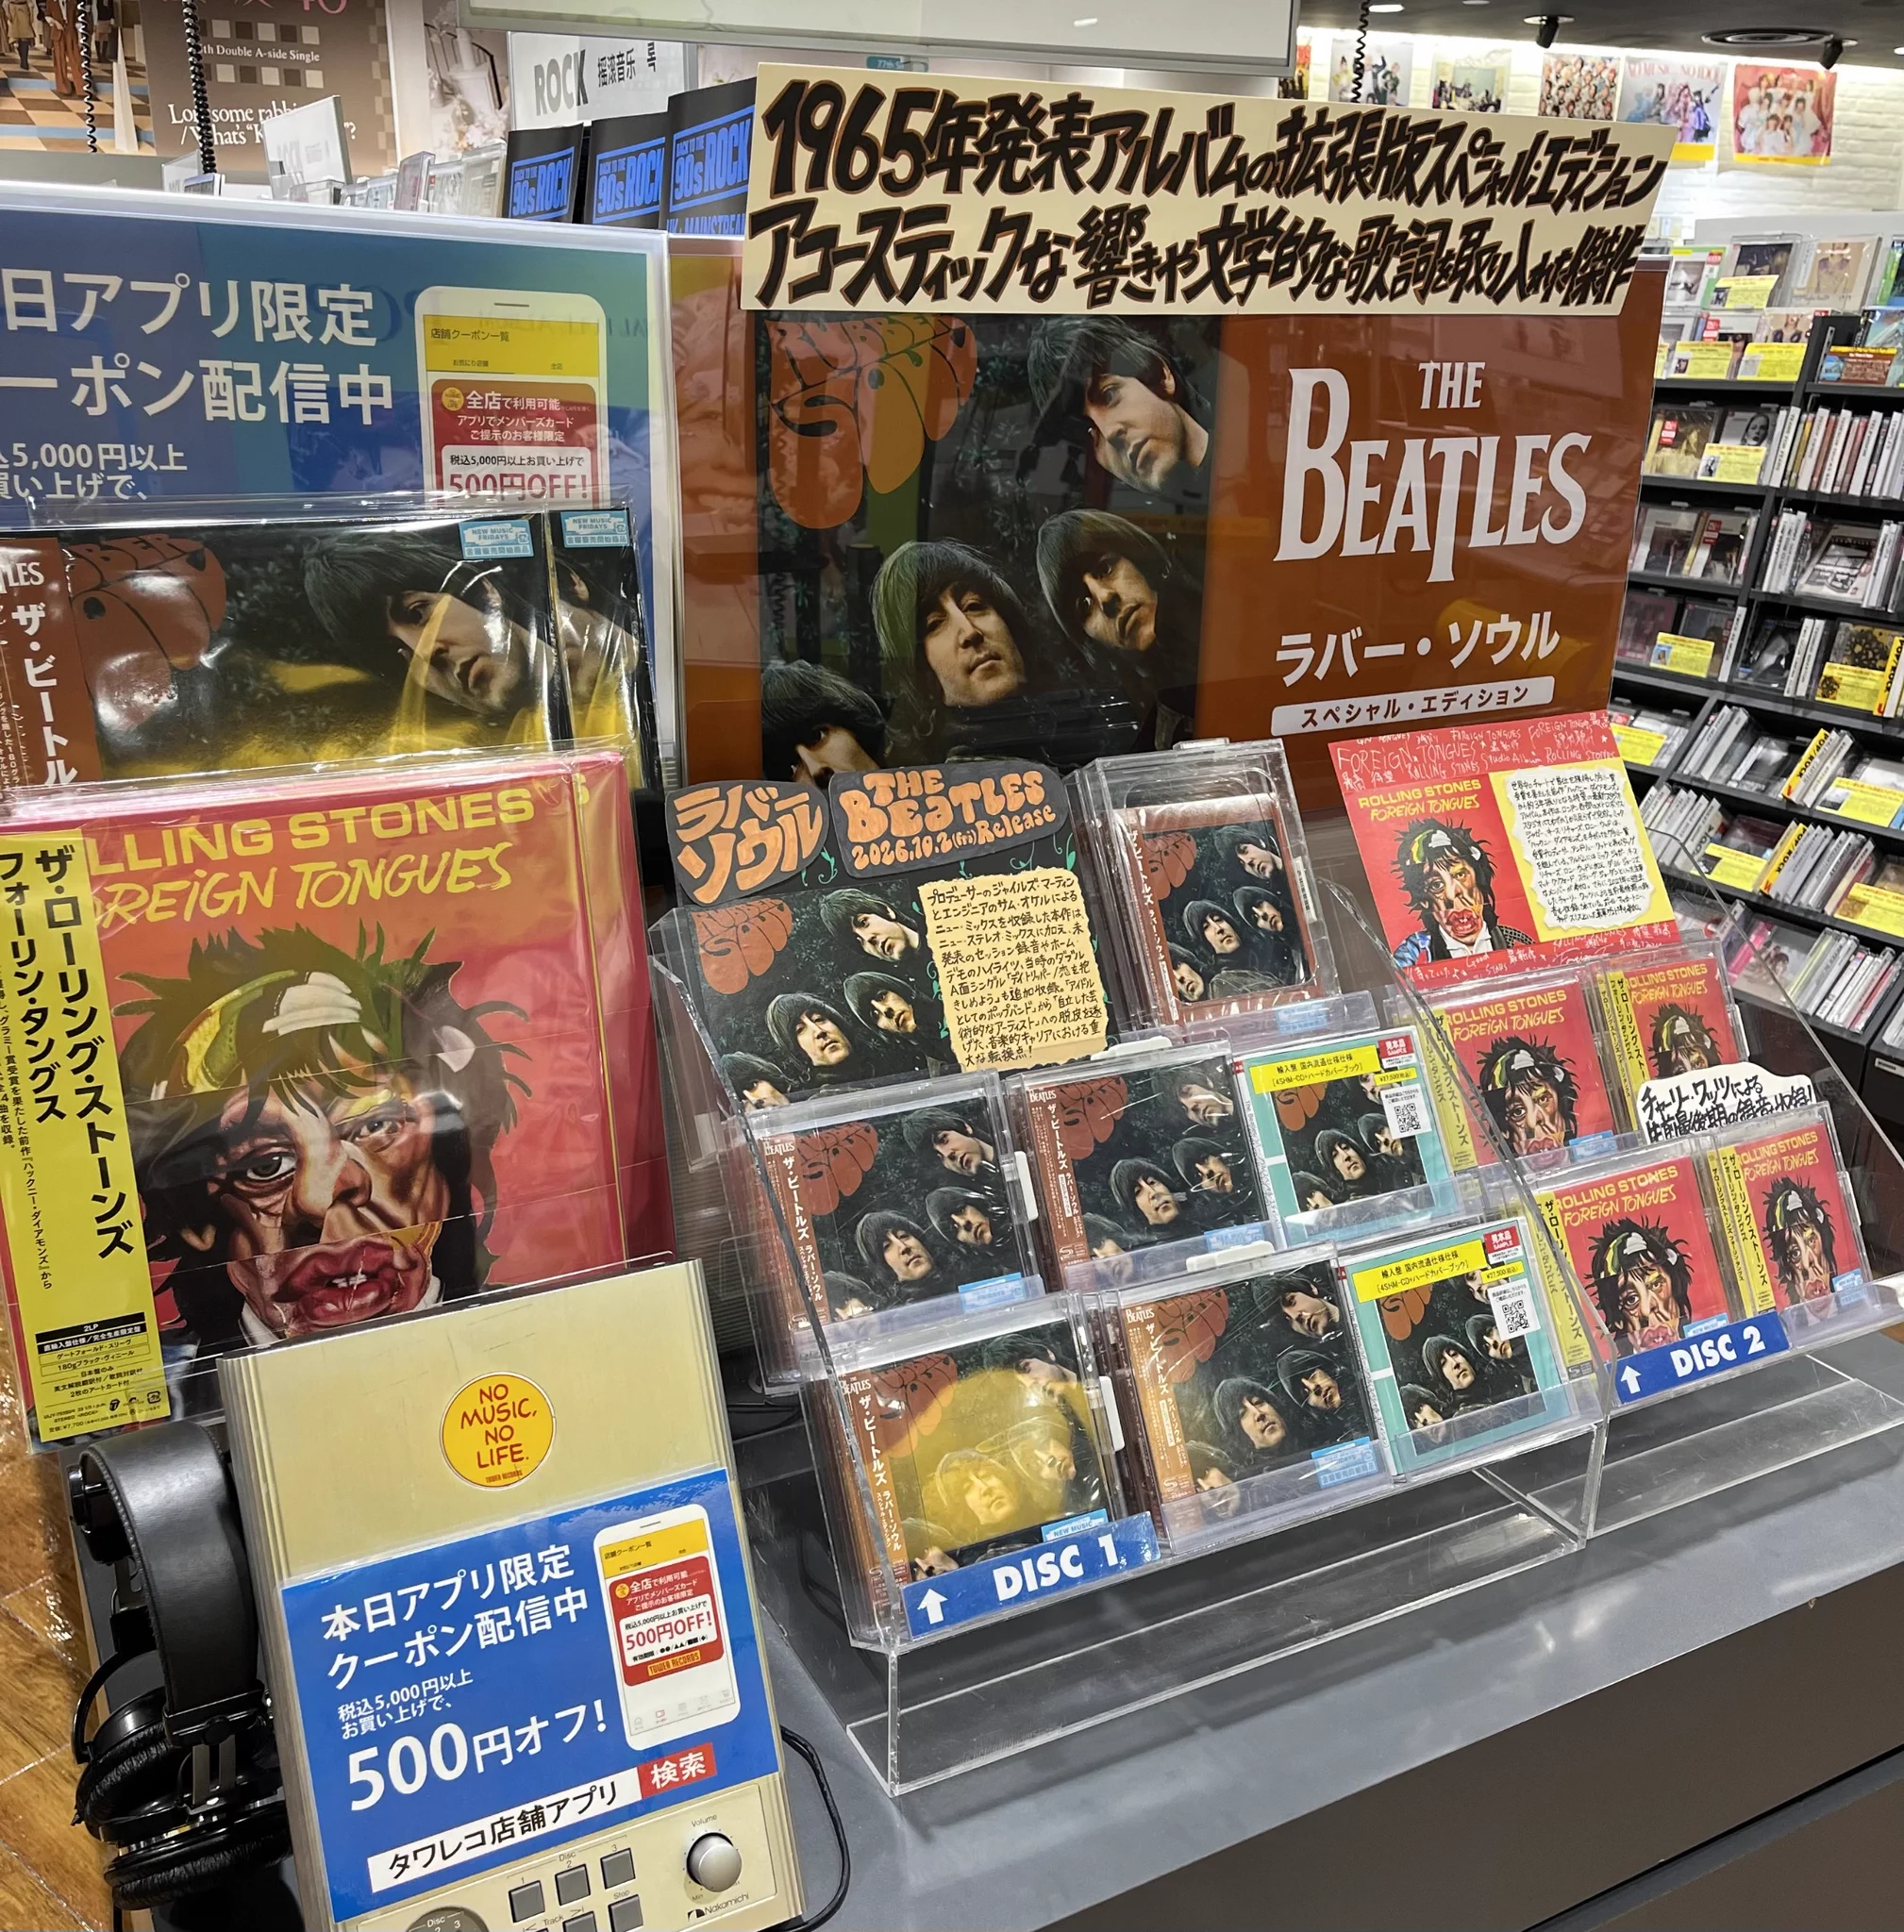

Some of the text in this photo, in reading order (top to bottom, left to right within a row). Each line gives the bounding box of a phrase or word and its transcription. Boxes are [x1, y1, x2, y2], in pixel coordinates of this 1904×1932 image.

[216, 45, 320, 63] Double A-side Single
[597, 48, 636, 88] 摇滚音乐
[534, 50, 588, 116] ROCK
[168, 104, 254, 124] Losome
[675, 119, 751, 200] 90s ROCK
[512, 158, 571, 216] 90s ROCK
[597, 174, 625, 212] 90s
[1, 268, 377, 346] 日アプリ限定
[431, 328, 509, 341] 店舗クーポン一覧
[1418, 361, 1486, 409] THE
[466, 390, 560, 411] 全店で利用可能
[458, 415, 574, 428] アプリでメンバーズカード
[471, 429, 565, 442] ご提示のお客様限定
[450, 455, 584, 467] 税込5,000円以上お買い上げで
[1273, 367, 1593, 583] BEATLES
[1275, 610, 1561, 688] ラバー・ソウル
[11, 602, 77, 787] ザ・ビートル
[1301, 685, 1529, 729] スペシャル・エディション
[1416, 741, 1477, 763] TONGUES
[863, 769, 944, 806] THE
[1358, 779, 1481, 809] ROLLING STONES
[290, 787, 536, 851] STONES
[674, 785, 810, 842] ラバー
[1428, 794, 1479, 814] TONGUES
[676, 804, 823, 904] ソウル
[289, 841, 514, 910] TONGUES
[1667, 964, 1708, 981] STONES
[1671, 979, 1708, 995] TONGUES
[0, 852, 67, 1124] フォーリン・タングス
[1446, 990, 1566, 1026] ROLLING STONES
[1511, 1007, 1565, 1030] TONGUES
[35, 844, 135, 1259] ザ・ローリング・ストーンズ
[1029, 1090, 1057, 1103] BEATLES
[1780, 1131, 1818, 1151] STONES
[1047, 1104, 1068, 1170] ザ・ビートルズ
[1066, 1172, 1079, 1215] ラバー・ソウル
[1783, 1149, 1819, 1169] TONGUES
[1556, 1165, 1679, 1209] ROLLING STONES
[1622, 1185, 1676, 1211] TONGUES
[782, 1157, 823, 1302] ザ・ビートルズ ラバー・ソウル
[1729, 1153, 1768, 1286] ザ・ローリング・ストーンズ
[84, 1324, 99, 1332] 2LP
[1126, 1307, 1156, 1324] BEATLES
[1669, 1325, 1765, 1378] DISC 2
[479, 1383, 509, 1405] NO
[460, 1398, 537, 1429] MUSIC,
[484, 1424, 514, 1445] NO
[477, 1442, 529, 1469] LIFE.
[859, 1394, 903, 1552] ザ・ビートルズ ラバー・ソウル
[1053, 1521, 1094, 1537] NEW MUSIC
[630, 1570, 689, 1594] 全店で利用可能
[993, 1533, 1119, 1602] DISC 1
[321, 1543, 576, 1642] 本日アプリ限定
[626, 1578, 698, 1606] アプリでメンバーズカード
[635, 1589, 693, 1612] ご提示のお客様限定
[625, 1600, 708, 1630] 税込5,000円以上お買い上げで
[326, 1587, 589, 1691] クーポン配信中
[626, 1610, 712, 1651] 500円OFF!
[649, 1655, 700, 1674] TOWER RECORDS
[338, 1668, 474, 1719] 税込5,000円以上
[342, 1695, 454, 1740] お買い上げで、
[349, 1699, 607, 1813] 500円オフ!
[651, 1751, 707, 1790] 検索
[388, 1780, 617, 1880] タワレコ店舗アプリ
[691, 1814, 718, 1827] Volume
[559, 1850, 576, 1862] Disc
[613, 1890, 631, 1900] Stop
[704, 1892, 750, 1914] Nakamichi
[426, 1916, 446, 1928] Disc
[454, 1920, 460, 1929] 3
[543, 1915, 564, 1926] Track
